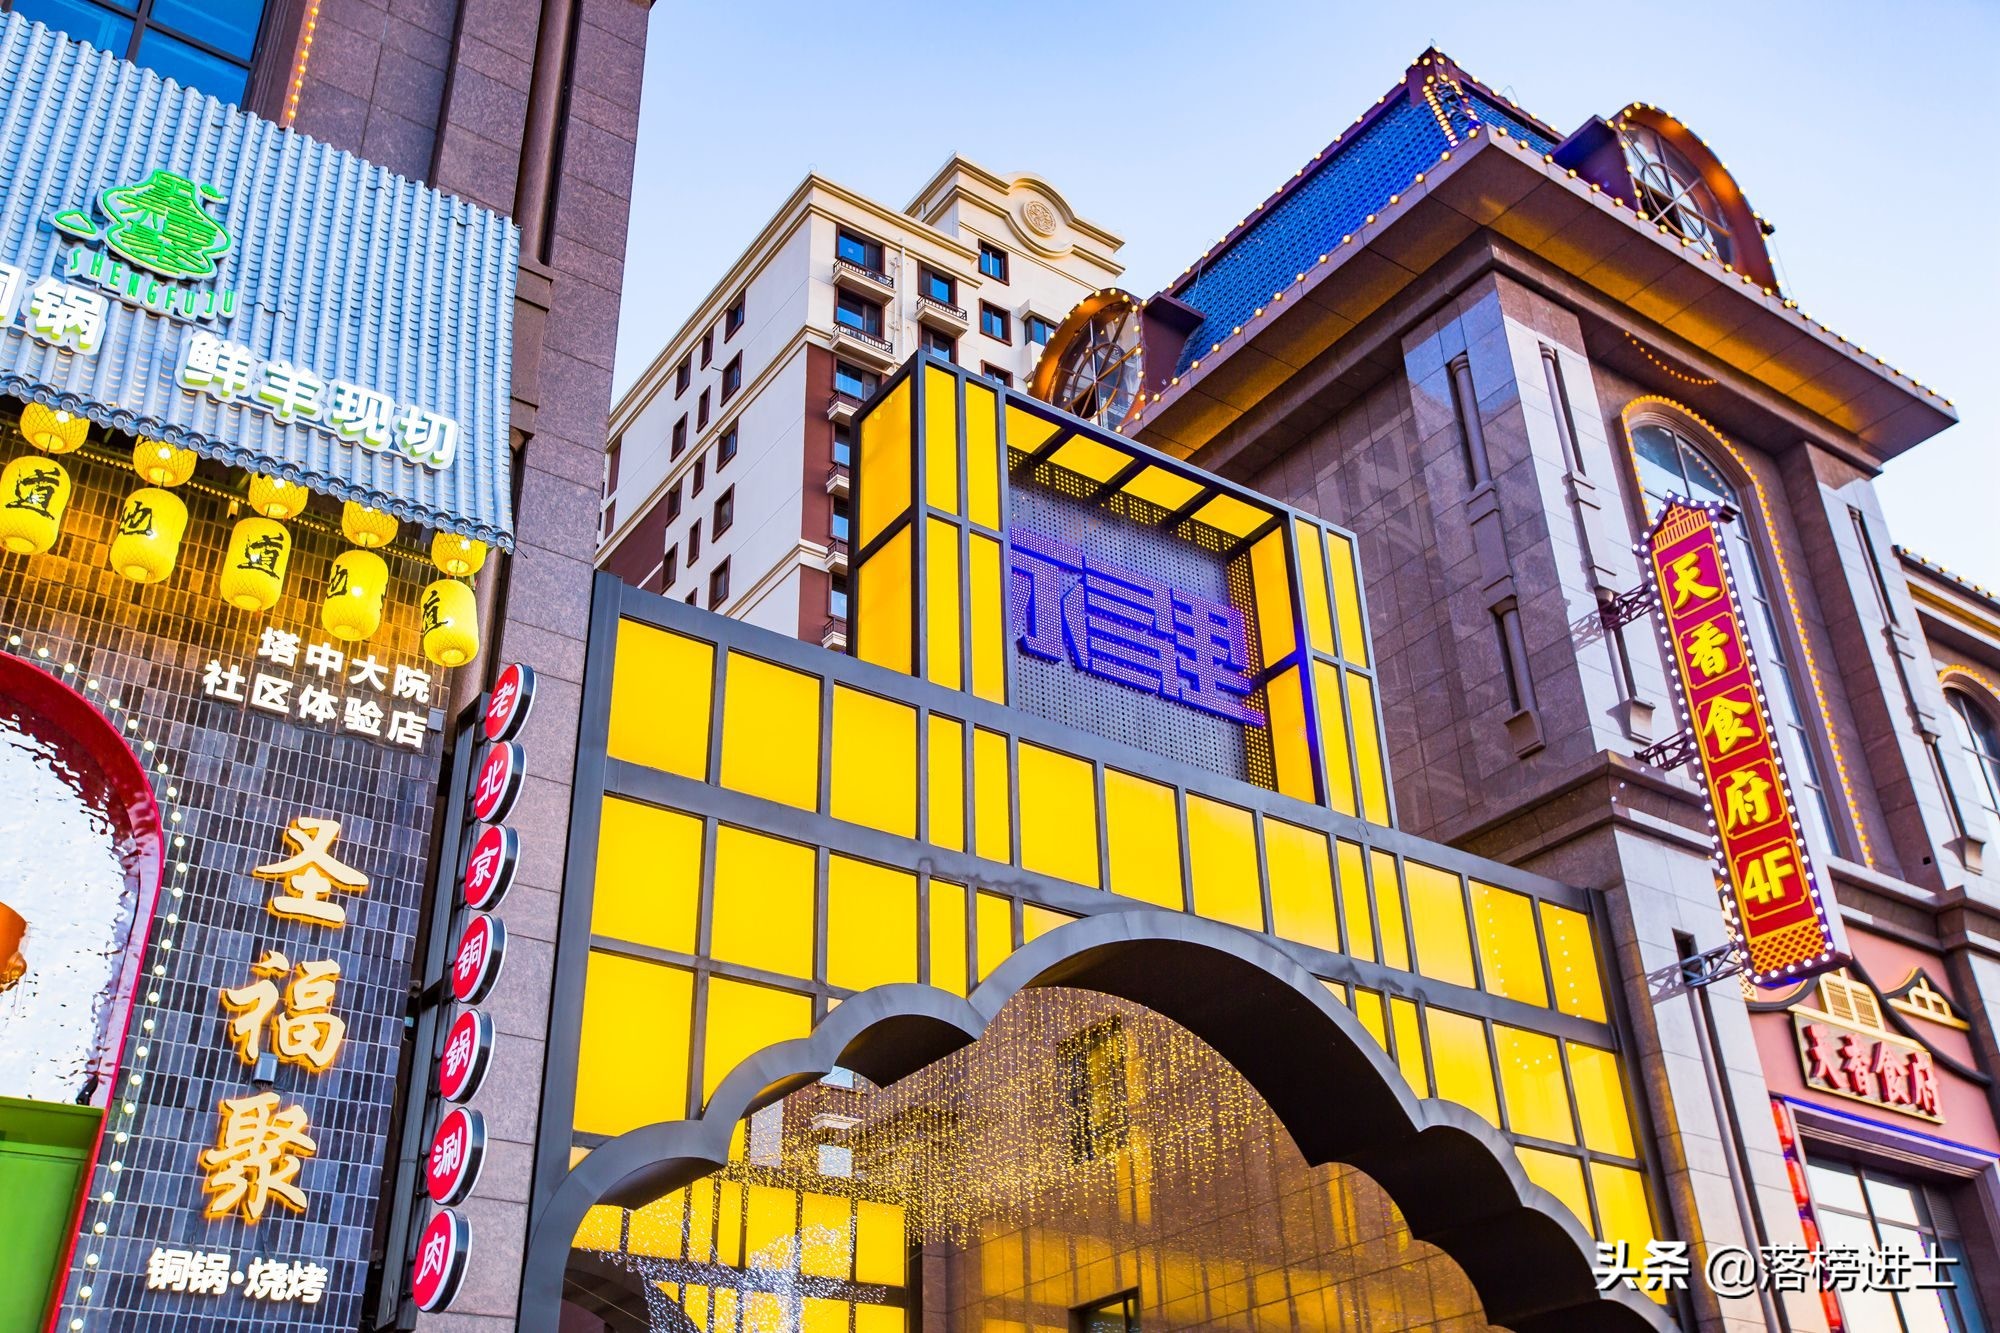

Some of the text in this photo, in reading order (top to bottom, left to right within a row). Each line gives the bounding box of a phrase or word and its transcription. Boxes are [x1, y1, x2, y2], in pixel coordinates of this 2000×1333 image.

[70, 248, 236, 315] SHENGFUJU
[184, 331, 453, 463] 鲜羊现切
[202, 659, 429, 749] 社区体验店
[258, 627, 432, 703] 塔中大院
[201, 816, 369, 1224] 圣福聚
[1802, 1023, 1942, 1117] 天香食府
[147, 1247, 329, 1304] 铜锅·烧烤
